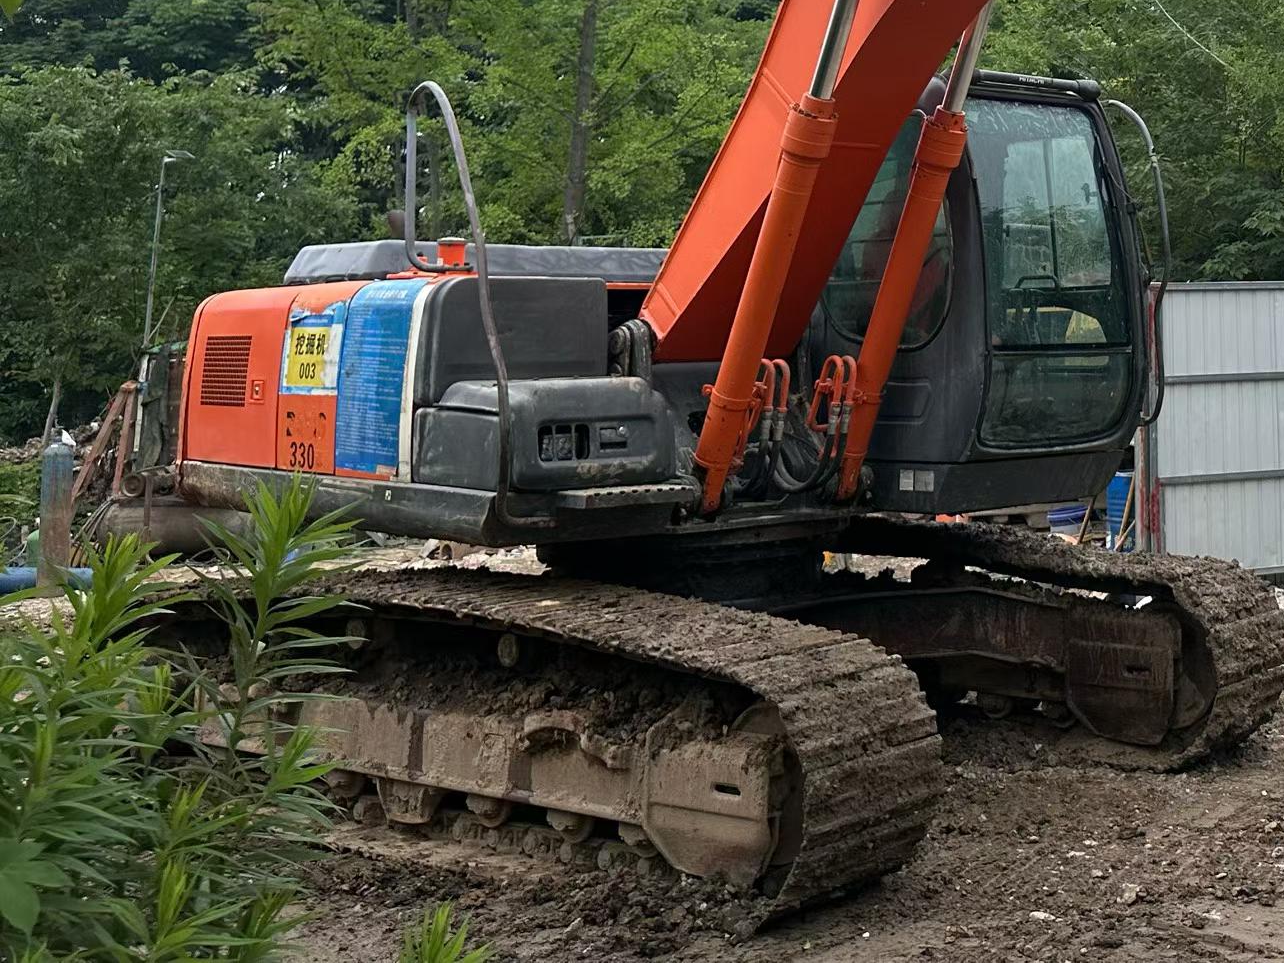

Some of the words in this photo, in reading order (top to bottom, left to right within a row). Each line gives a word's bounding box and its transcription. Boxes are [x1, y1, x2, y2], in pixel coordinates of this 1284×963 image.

[295, 333, 326, 356] 挖掘机
[299, 362, 316, 379] 003
[289, 441, 315, 470] 330
